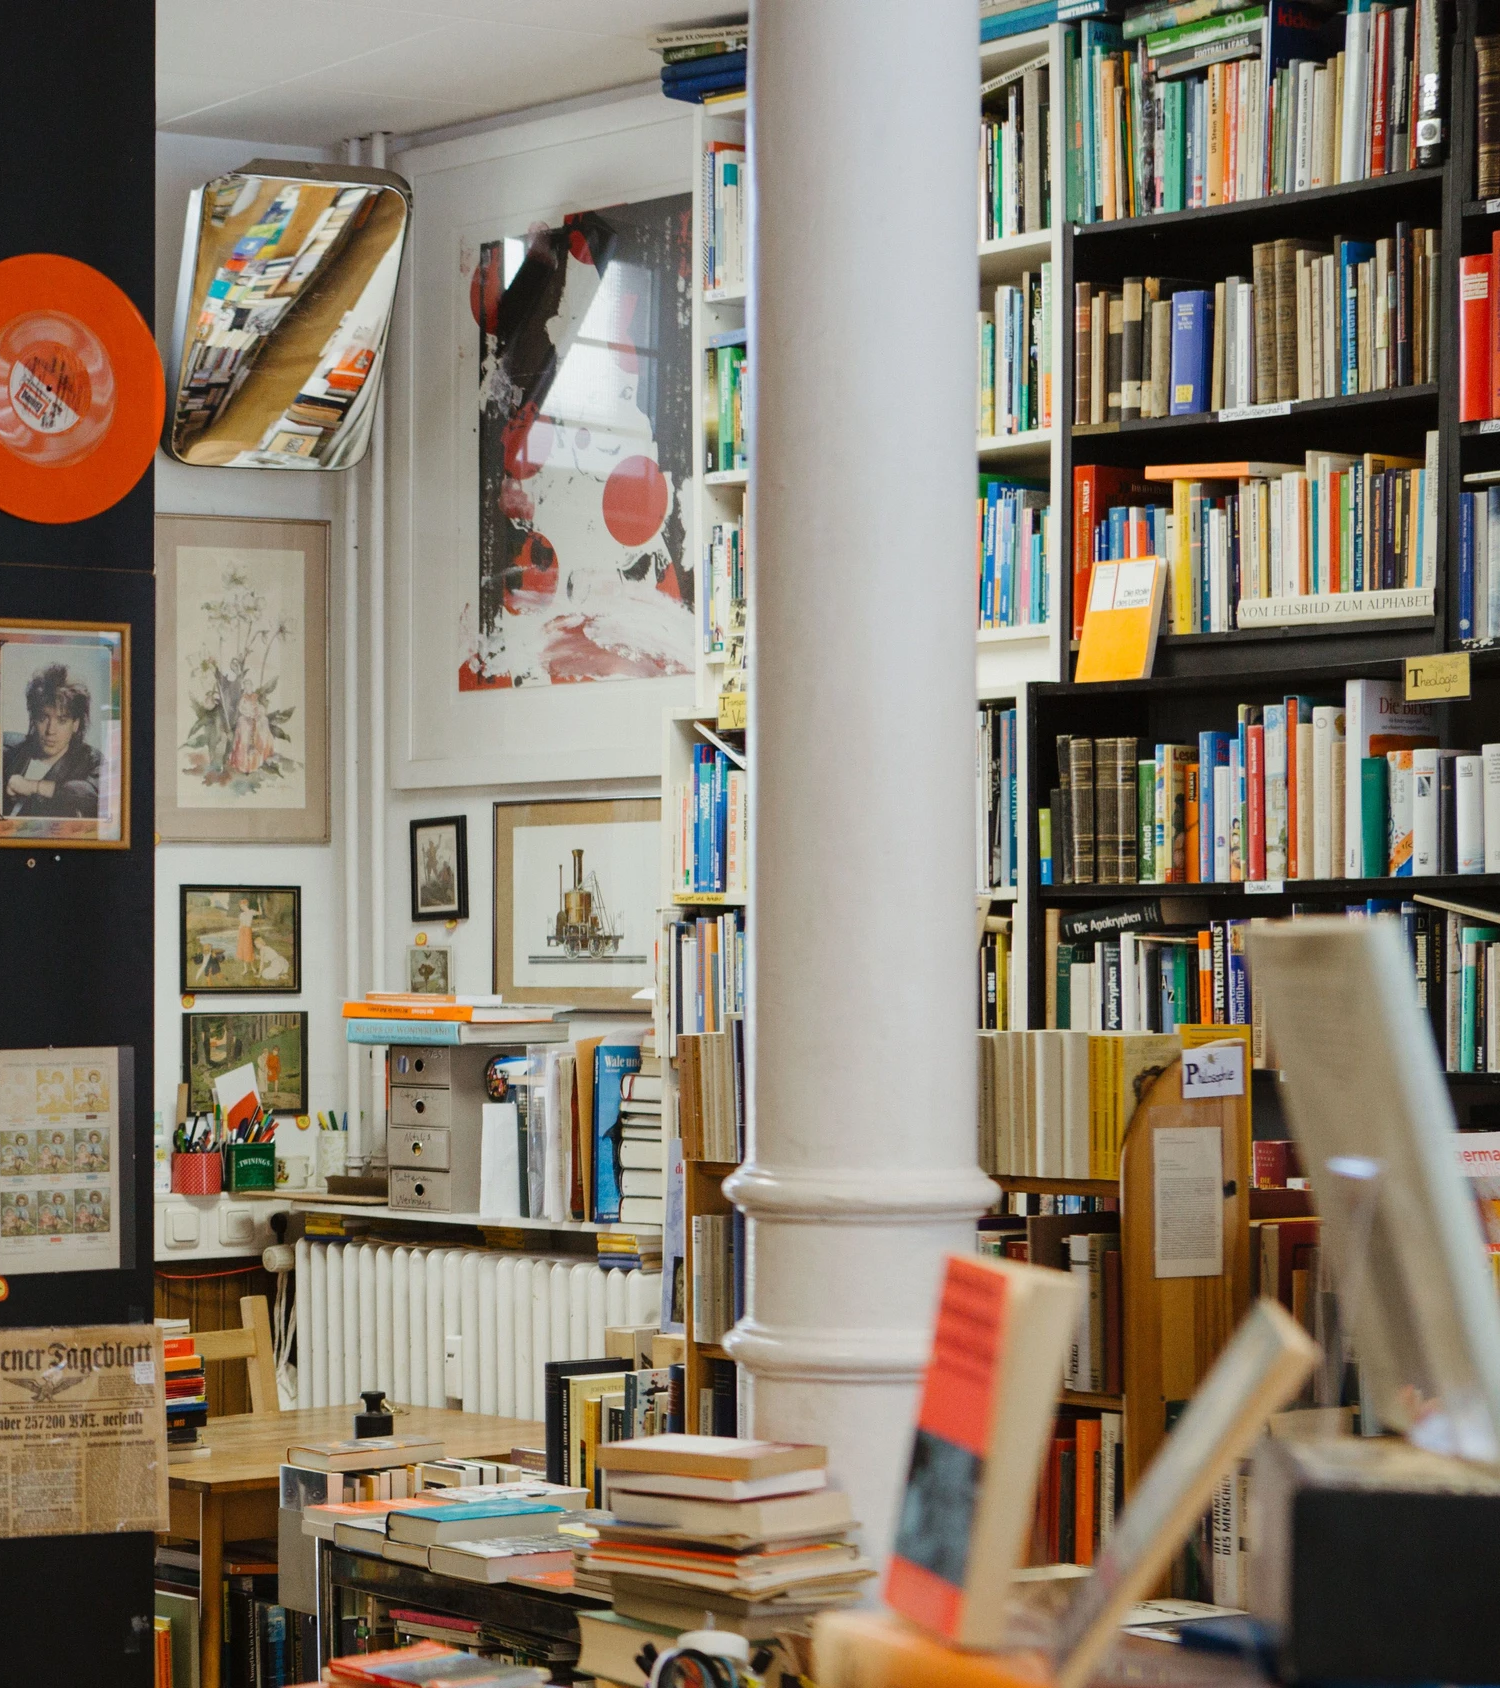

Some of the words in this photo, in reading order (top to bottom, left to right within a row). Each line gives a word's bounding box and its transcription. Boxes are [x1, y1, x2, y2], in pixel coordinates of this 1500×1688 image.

[1224, 12, 1246, 28] 90
[1194, 42, 1226, 59] FOOTBALL
[1228, 36, 1249, 50] LEAKS
[1374, 100, 1384, 123] Jahre
[1374, 124, 1382, 136] 50
[1355, 536, 1363, 557] Frank
[1355, 558, 1363, 587] Manfred
[1116, 599, 1128, 608] des
[1128, 597, 1148, 607] Lesers
[1124, 588, 1134, 598] Die
[1134, 588, 1150, 598] Rolle
[1241, 606, 1269, 619] VOM
[1274, 602, 1330, 616] FELSBILD
[1334, 599, 1363, 613] ZUM
[1366, 595, 1430, 610] ALPHABET
[1408, 668, 1459, 692] Theologie
[1379, 697, 1400, 714] Die
[1142, 825, 1152, 860] Anstoß
[1073, 921, 1088, 934] Die
[1090, 911, 1142, 930] Apokryphen
[1214, 926, 1224, 1009] KATECHISMUS
[1416, 934, 1427, 979] Testament
[1107, 966, 1120, 1029] Apokryphen
[1236, 968, 1245, 1025] Bibelführer
[396, 1025, 450, 1036] WONDERLAND
[604, 1055, 625, 1068] Wale
[1184, 1063, 1236, 1088] Philosophie
[238, 1156, 272, 1168] TWININGS
[48, 1342, 152, 1374] Tageblatt
[24, 1414, 66, 1429] 257200
[102, 1411, 143, 1428] versenkt
[1222, 1474, 1231, 1533] MENSCHEN
[1222, 1536, 1231, 1556] DES
